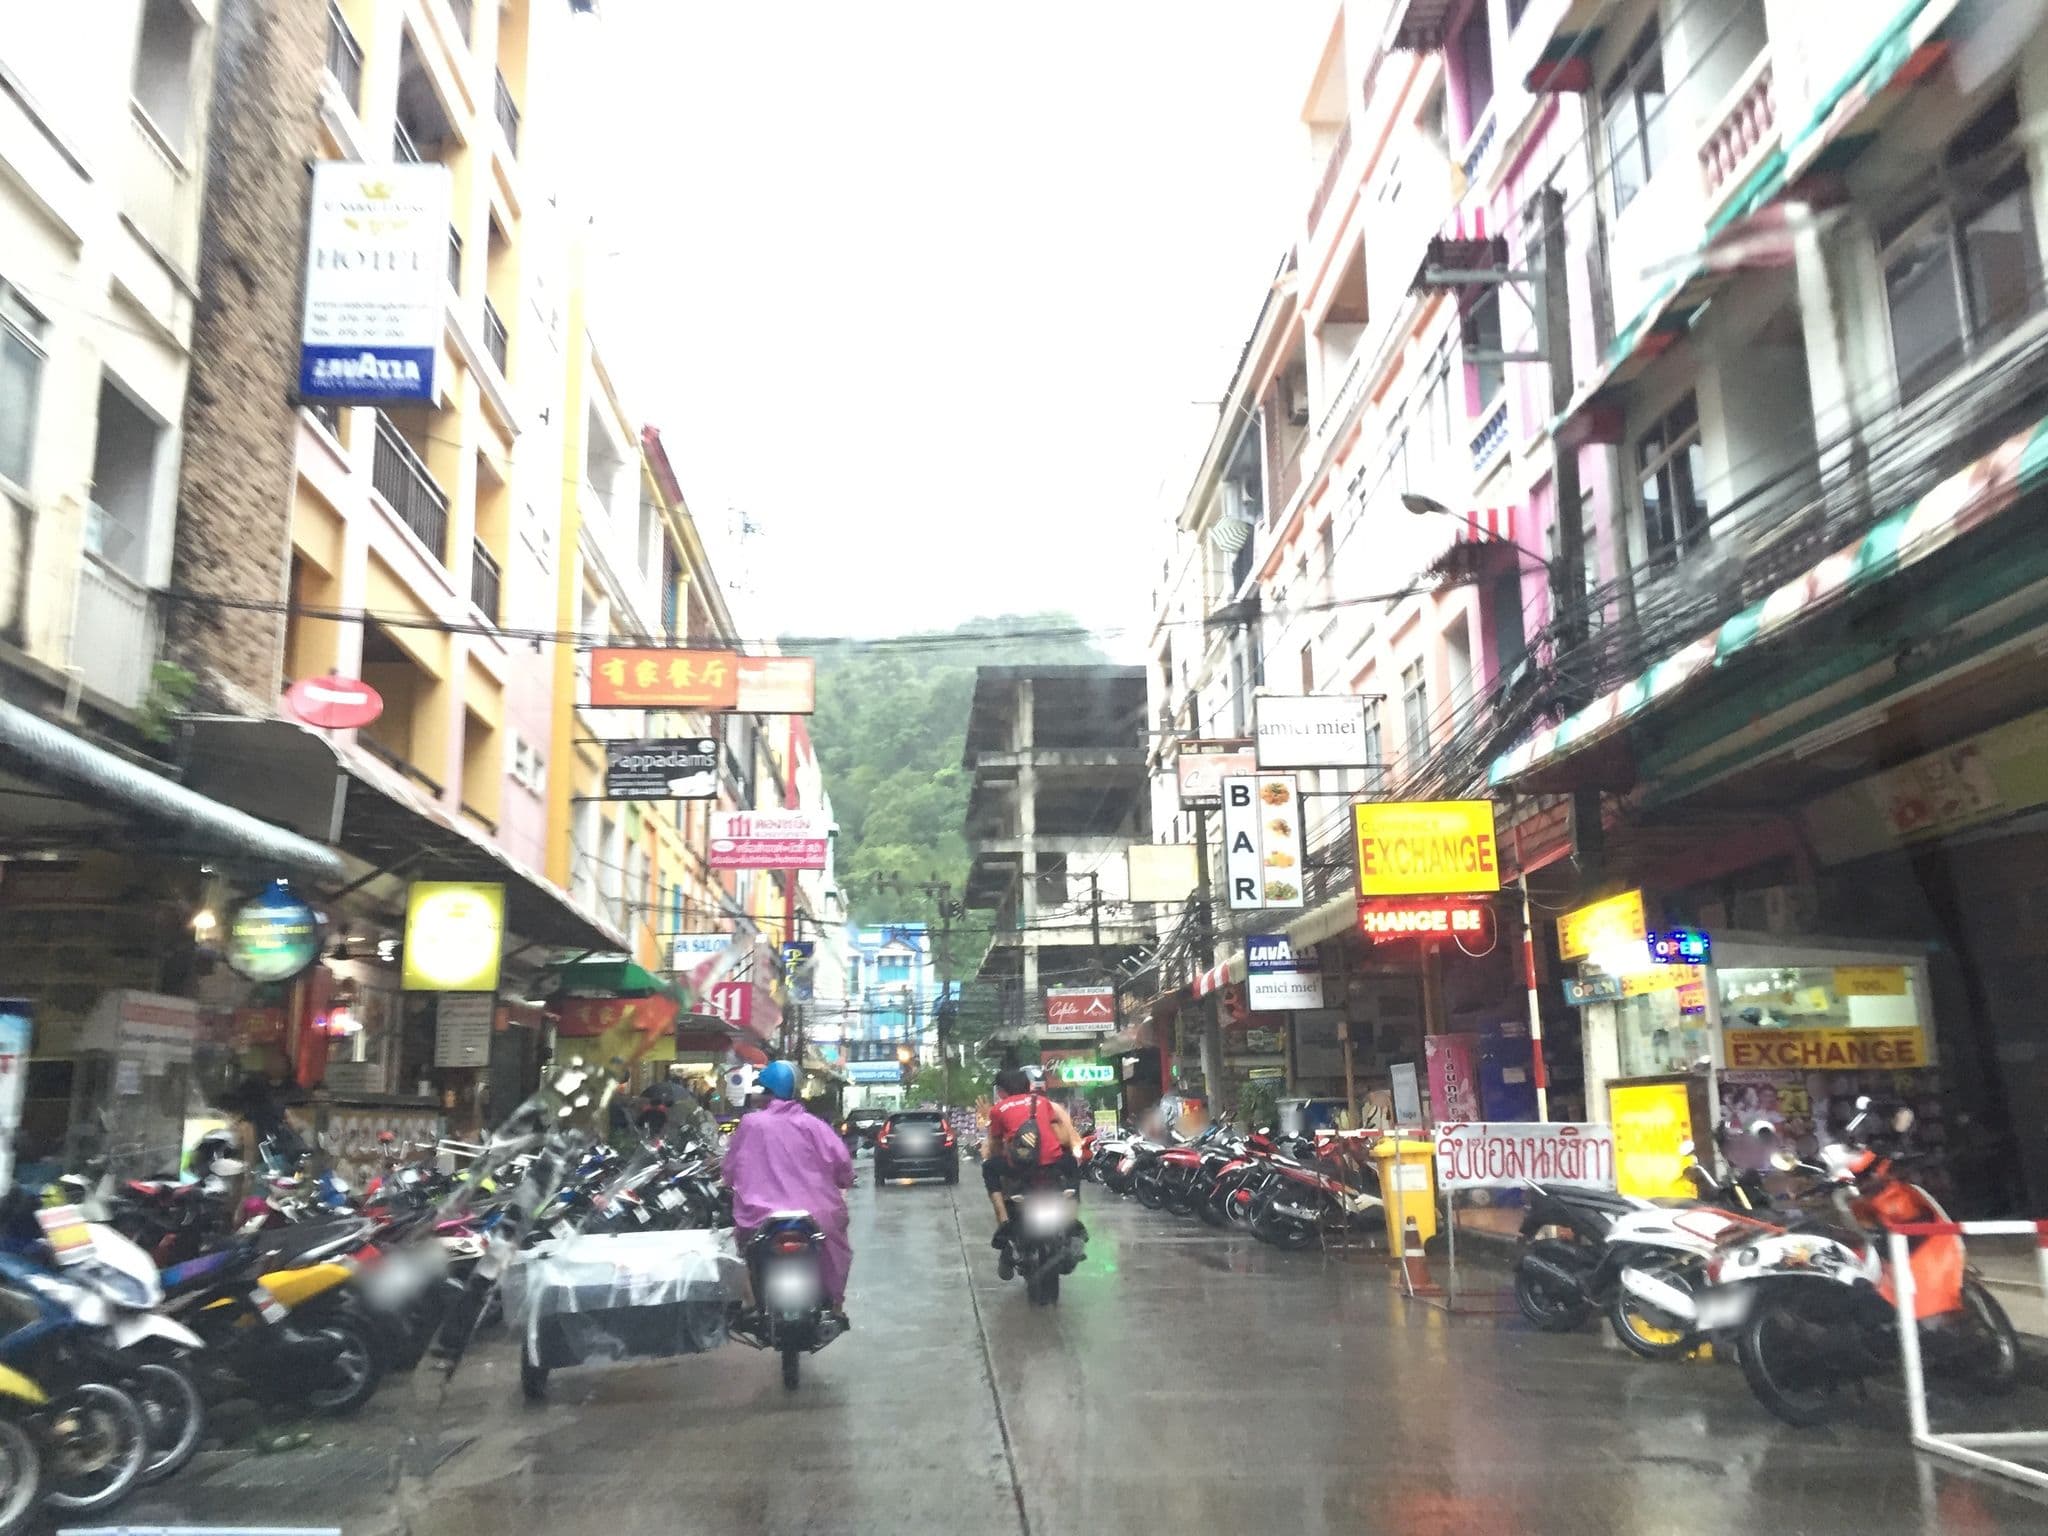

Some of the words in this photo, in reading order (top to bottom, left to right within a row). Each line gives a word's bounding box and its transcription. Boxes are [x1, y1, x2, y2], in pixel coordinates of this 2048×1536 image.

[1315, 717, 1357, 735] miei
[1362, 835, 1494, 876] EXCHANGE
[1656, 941, 1704, 955] OPEN
[1255, 981, 1288, 994] amici
[1291, 979, 1317, 993] miei
[1733, 1040, 1916, 1065] EXCHANGE
[1438, 1124, 1613, 1180] รับซ่อมนาฬิกา
